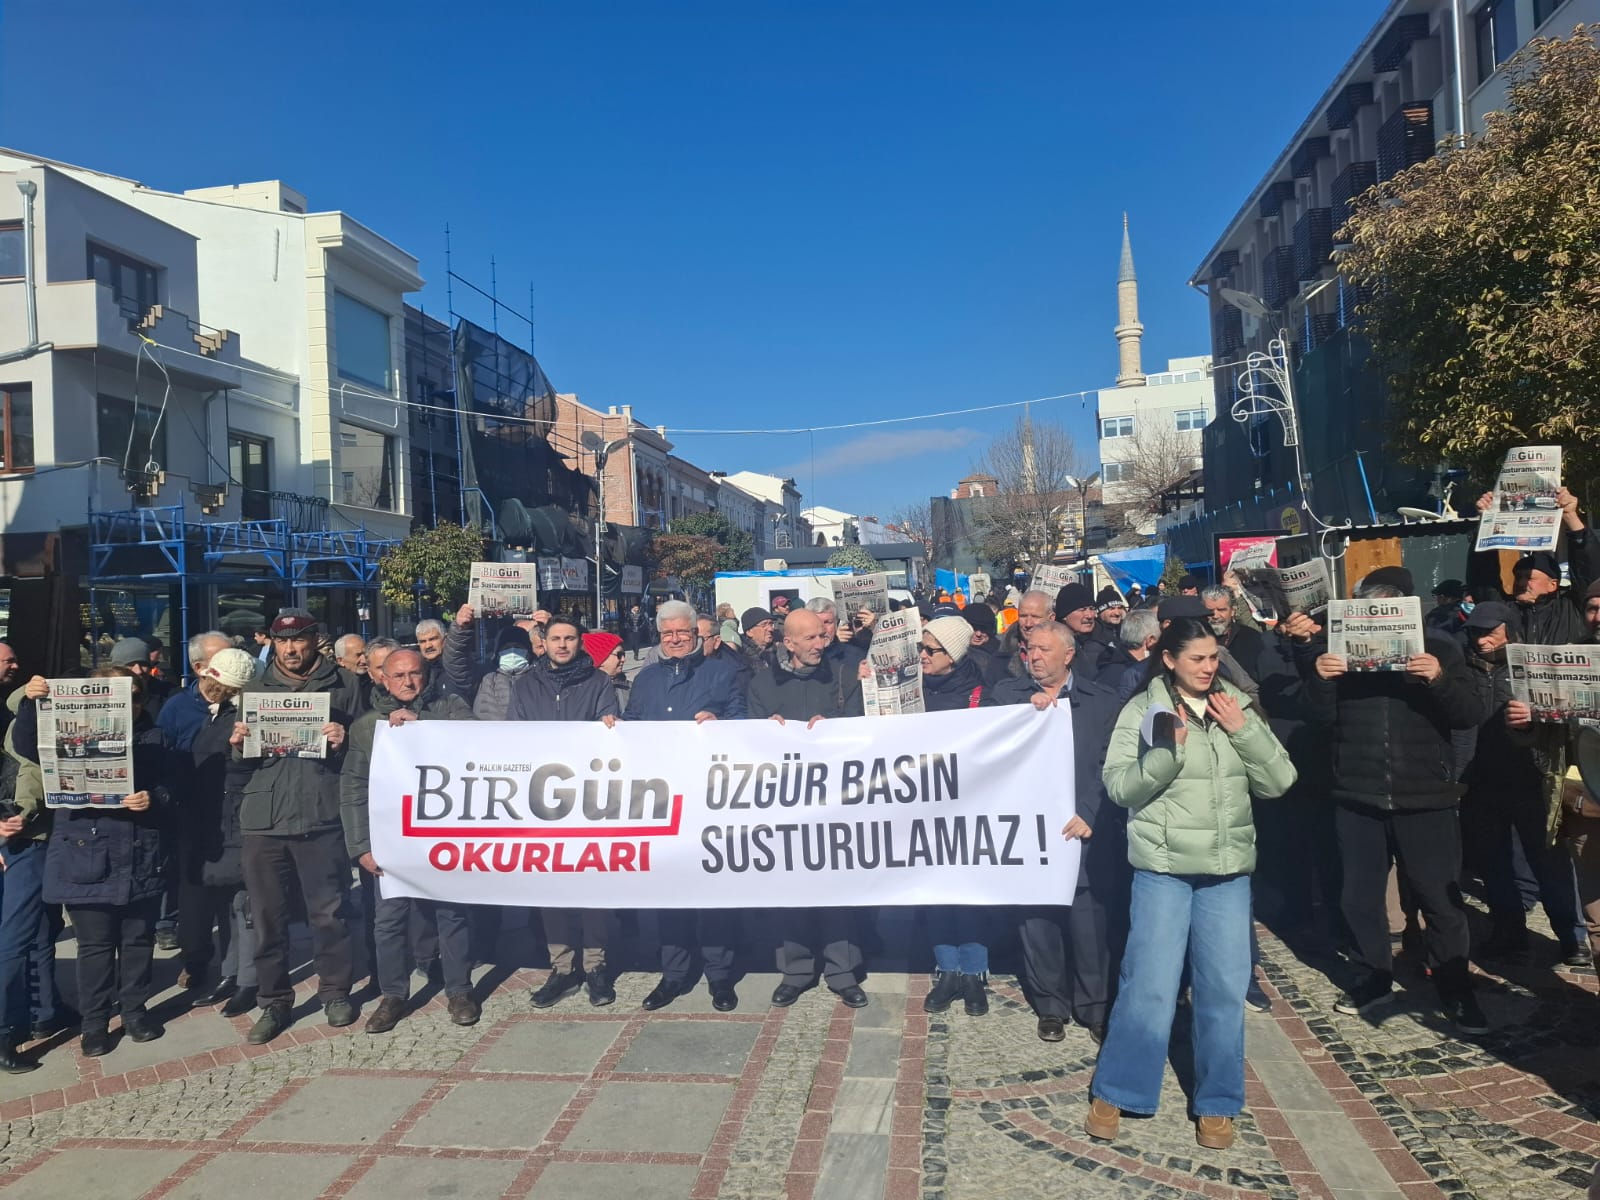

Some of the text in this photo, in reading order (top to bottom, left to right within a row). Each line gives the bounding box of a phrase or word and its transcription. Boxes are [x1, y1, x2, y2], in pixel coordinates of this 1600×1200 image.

[1346, 603, 1399, 616] BİRGün
[1345, 623, 1417, 632] Susturamazsınız
[1526, 651, 1586, 664] BİRGün
[56, 683, 110, 696] BİRGün
[55, 702, 126, 710] Susturamazsınız
[262, 698, 310, 709] BİRGün
[260, 714, 325, 723] Susturamazsınız
[480, 762, 532, 772] HALKIN GAZETESİ
[706, 753, 959, 810] ÖZGÜR BASIN
[415, 758, 669, 821] BİRGün
[701, 814, 1049, 873] SUSTURULAMAZ !
[428, 841, 650, 873] OKURLARI
